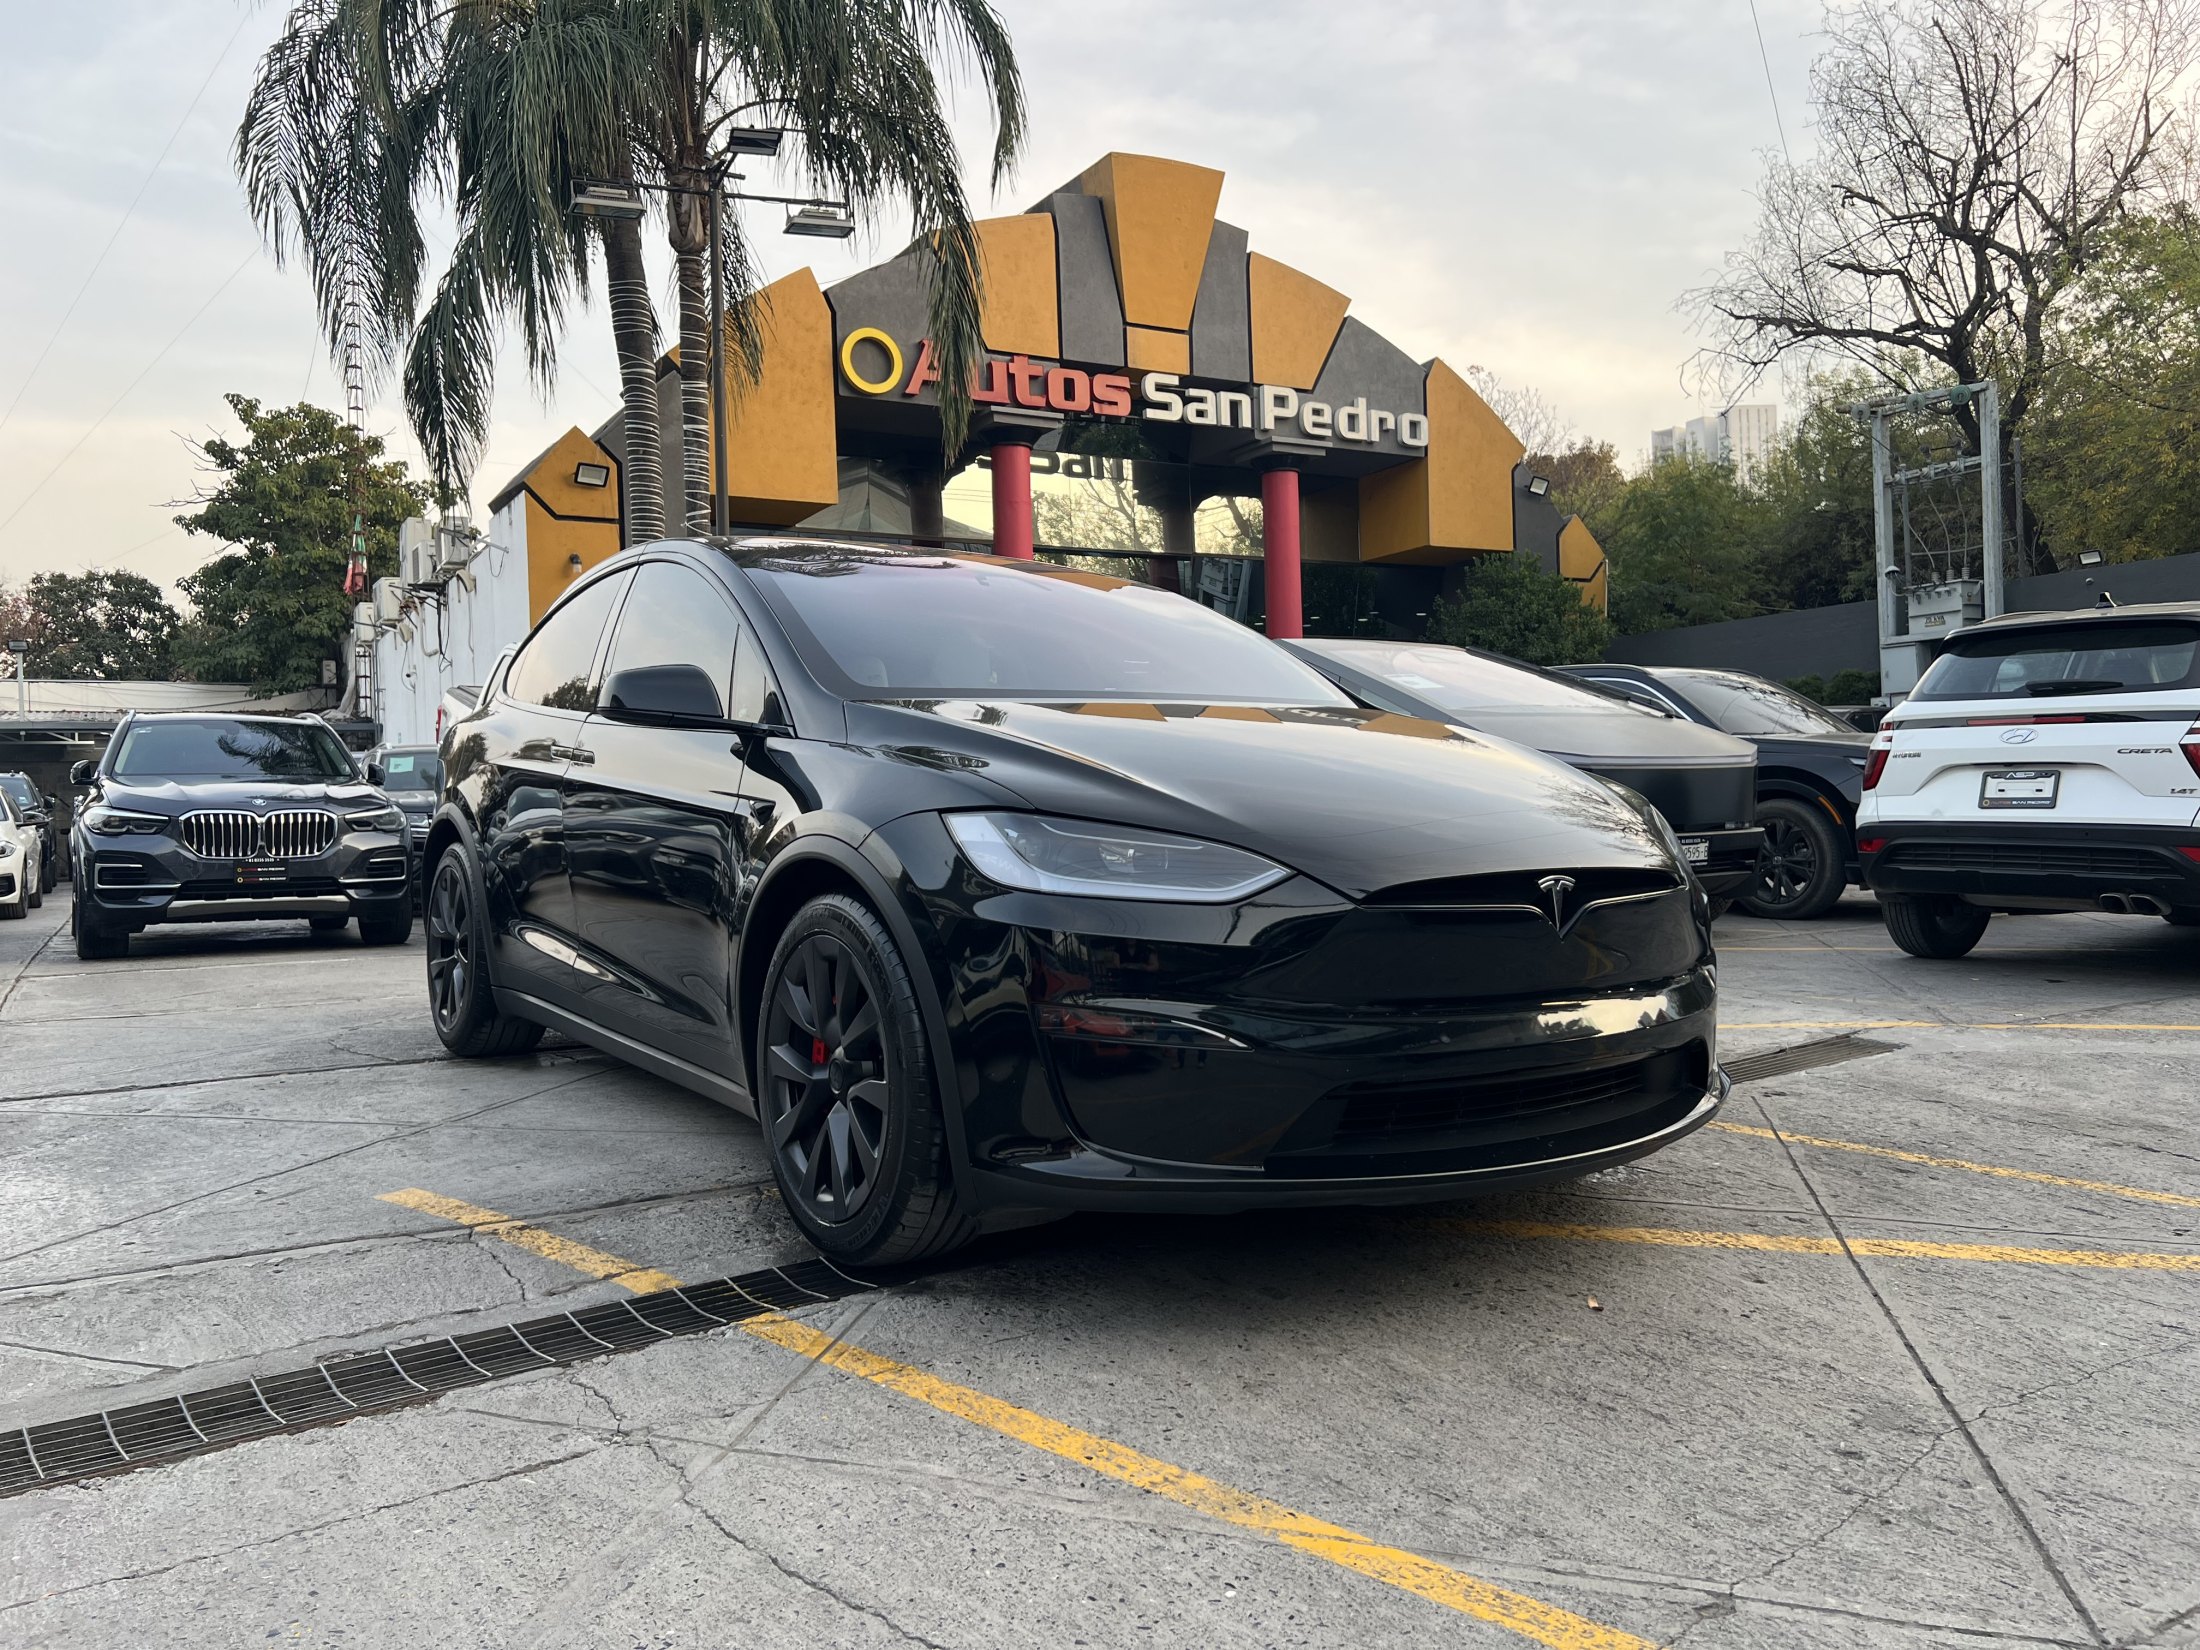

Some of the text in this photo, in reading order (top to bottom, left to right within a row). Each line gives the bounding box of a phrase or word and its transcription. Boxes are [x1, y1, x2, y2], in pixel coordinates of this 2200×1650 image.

[905, 338, 1429, 447] Autos San Pedro
